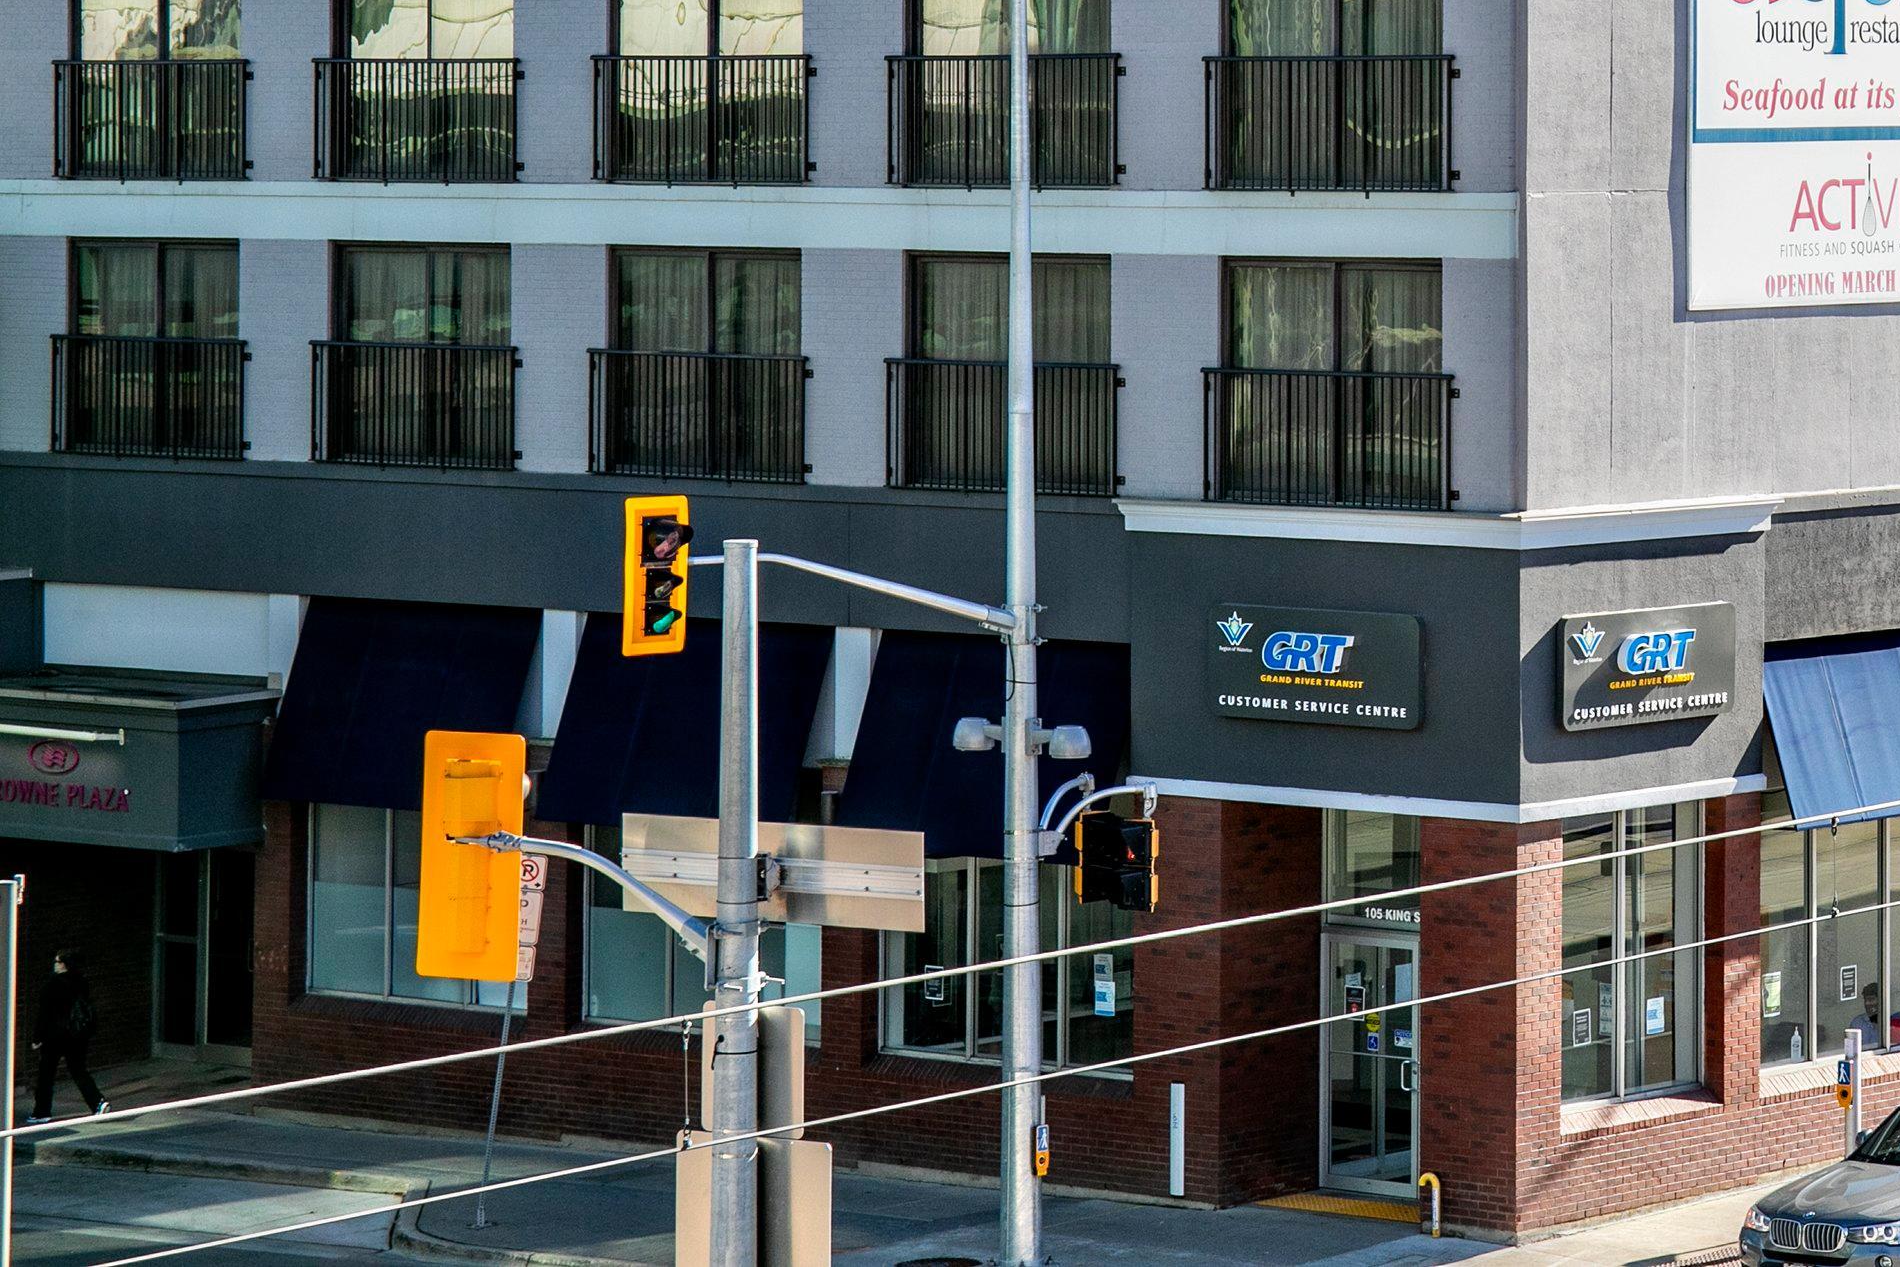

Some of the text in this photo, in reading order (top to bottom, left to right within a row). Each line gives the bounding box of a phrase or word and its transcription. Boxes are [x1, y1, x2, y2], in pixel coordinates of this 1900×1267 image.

[1756, 11, 1828, 51] lounge
[1723, 78, 1826, 118] Seafood
[1834, 83, 1857, 110] at
[1866, 79, 1895, 109] its
[1780, 242, 1820, 259] FITNESS
[1824, 241, 1846, 256] AND
[1851, 240, 1894, 257] SQUASH
[1765, 272, 1834, 298] OPENING
[1842, 269, 1896, 294] MARCH
[1262, 632, 1354, 674] GRT
[1617, 628, 1697, 675] GRT
[1260, 674, 1364, 690] GRAND RIVER TRANSIT
[1609, 672, 1695, 690] GRAND RIVER TRANSIT
[1218, 694, 1407, 719] CUSTOMER SERVICE CENTRE
[1573, 692, 1728, 721] CUSTOMER SERVICE CENTRE
[1365, 907, 1382, 920] 105
[1385, 909, 1411, 922] KING
